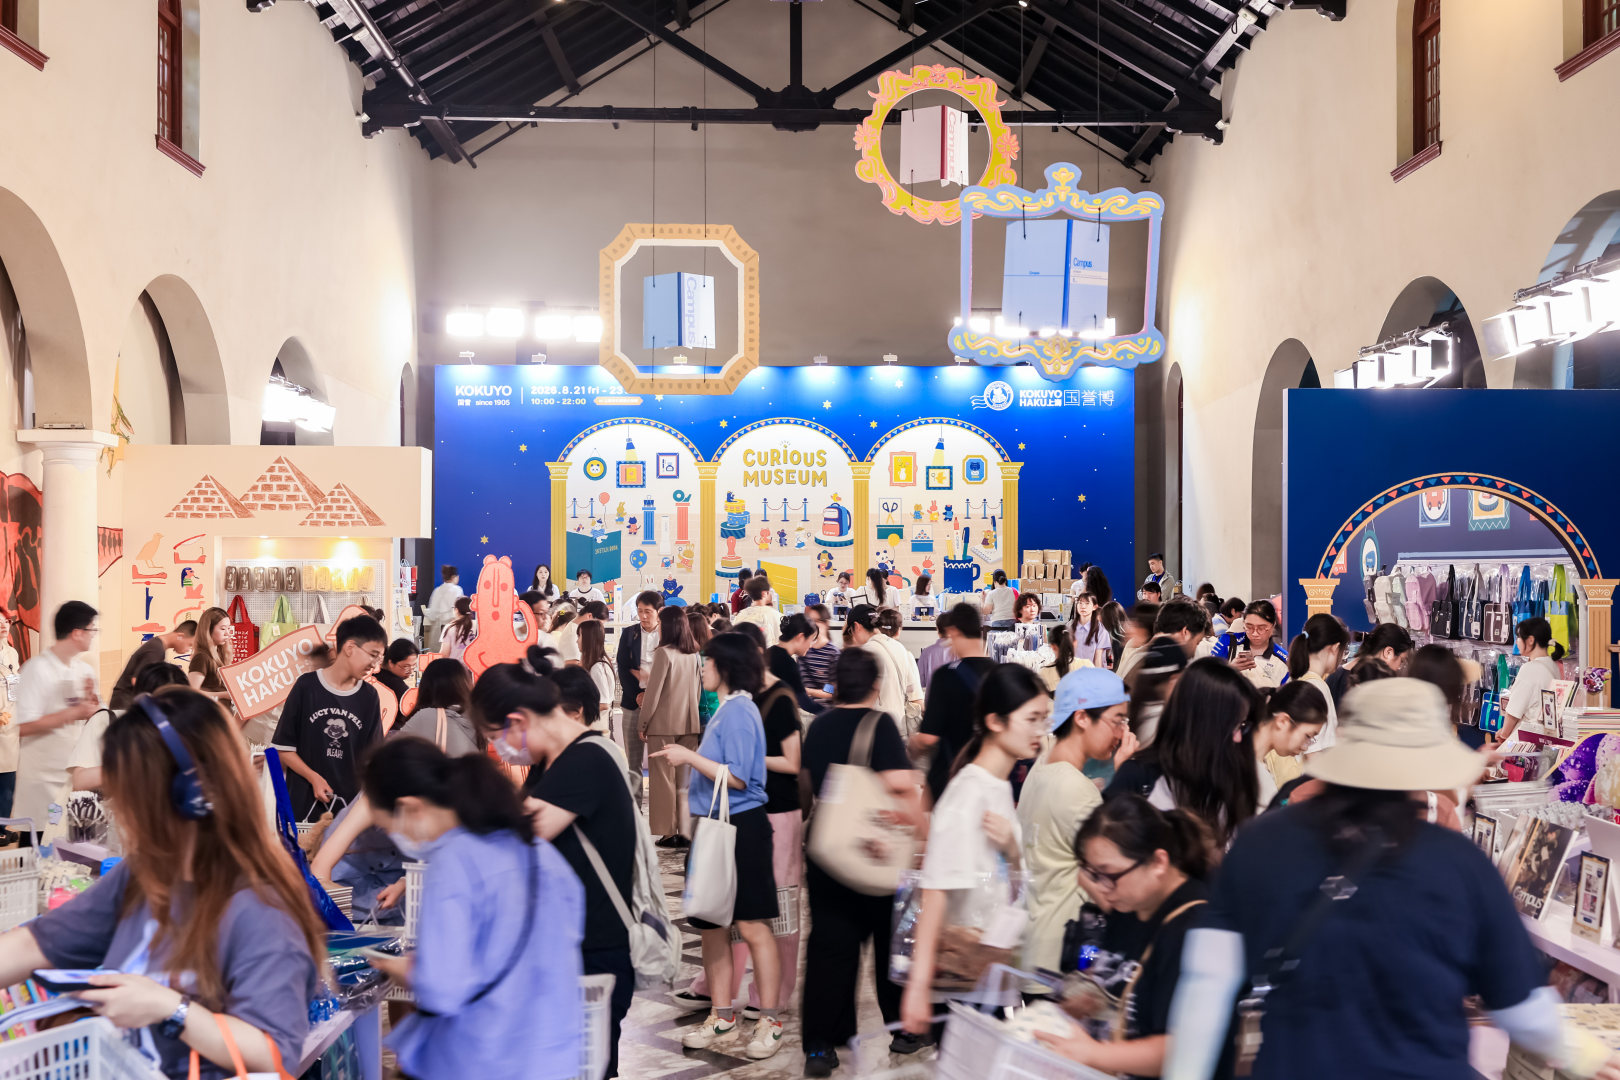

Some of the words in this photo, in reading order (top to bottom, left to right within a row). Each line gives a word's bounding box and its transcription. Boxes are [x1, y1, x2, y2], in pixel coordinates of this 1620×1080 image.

[686, 276, 698, 345] Campus
[455, 385, 513, 397] KOKUYO
[1019, 389, 1063, 399] KOKUYO
[1063, 389, 1115, 407] 国誉博
[742, 468, 828, 487] MUSEUM
[235, 638, 313, 691] KOKUYO
[309, 708, 329, 723] LUCY
[330, 707, 348, 717] VAN
